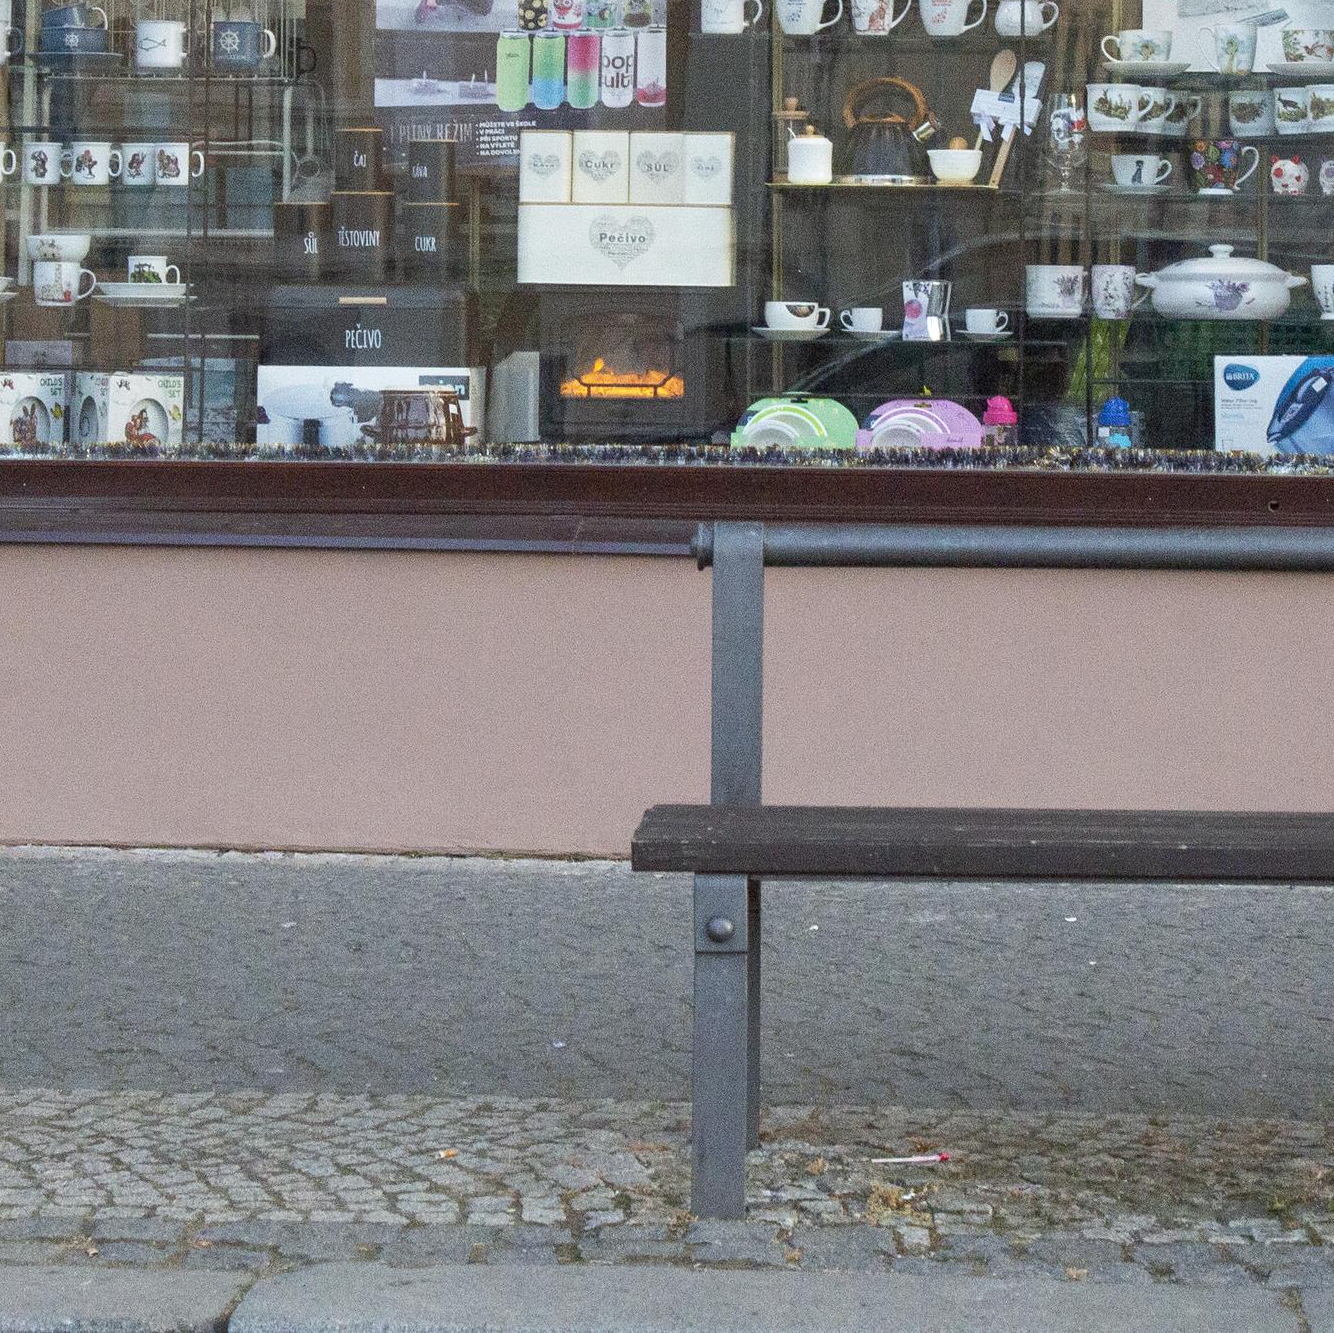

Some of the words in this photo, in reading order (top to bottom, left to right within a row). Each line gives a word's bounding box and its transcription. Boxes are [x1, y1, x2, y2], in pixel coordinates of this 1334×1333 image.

[585, 160, 615, 169] Cukr
[338, 225, 380, 248] TĚSTOVINY
[414, 236, 436, 252] CUKR
[599, 231, 646, 244] Pečivo
[345, 323, 382, 349] PEČIVO
